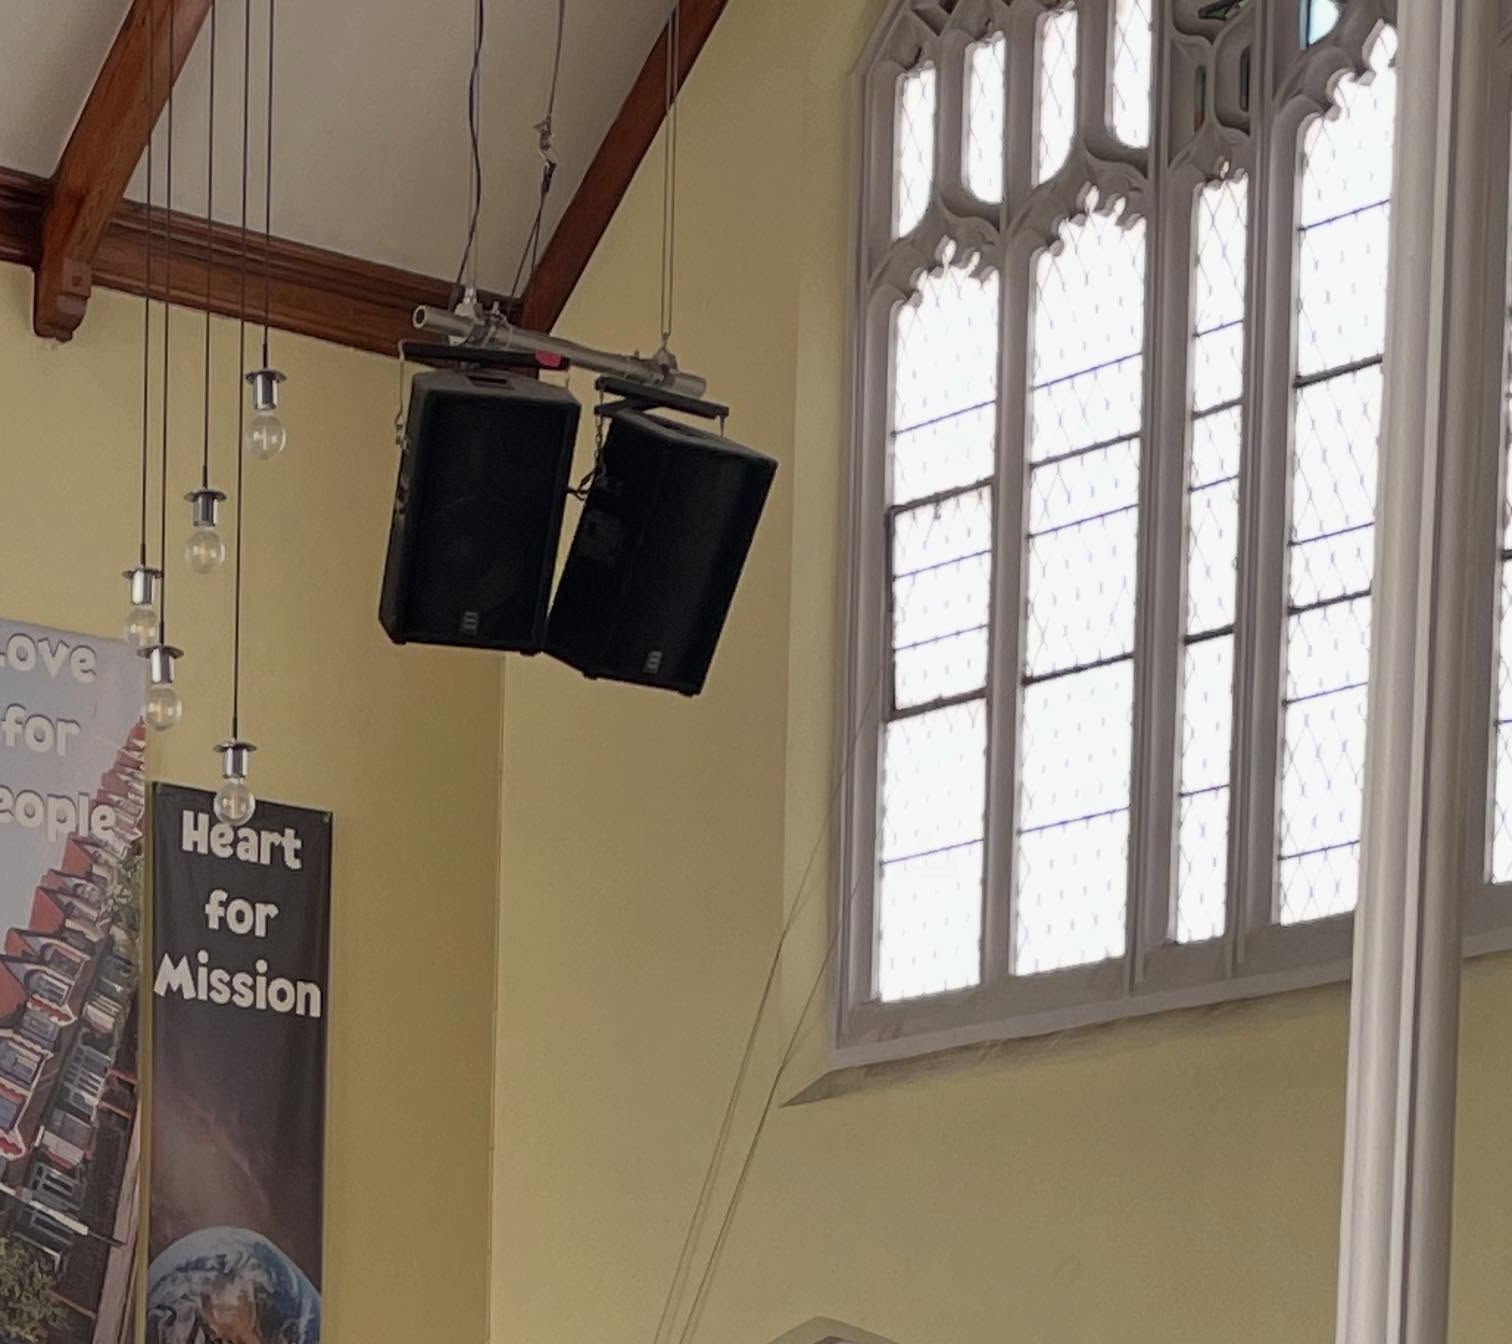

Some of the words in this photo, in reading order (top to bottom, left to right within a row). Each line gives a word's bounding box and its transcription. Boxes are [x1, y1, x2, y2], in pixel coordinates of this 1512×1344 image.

[1, 703, 82, 757] for
[182, 810, 303, 870] Heart
[205, 889, 280, 938] for
[153, 950, 322, 1018] Mission
